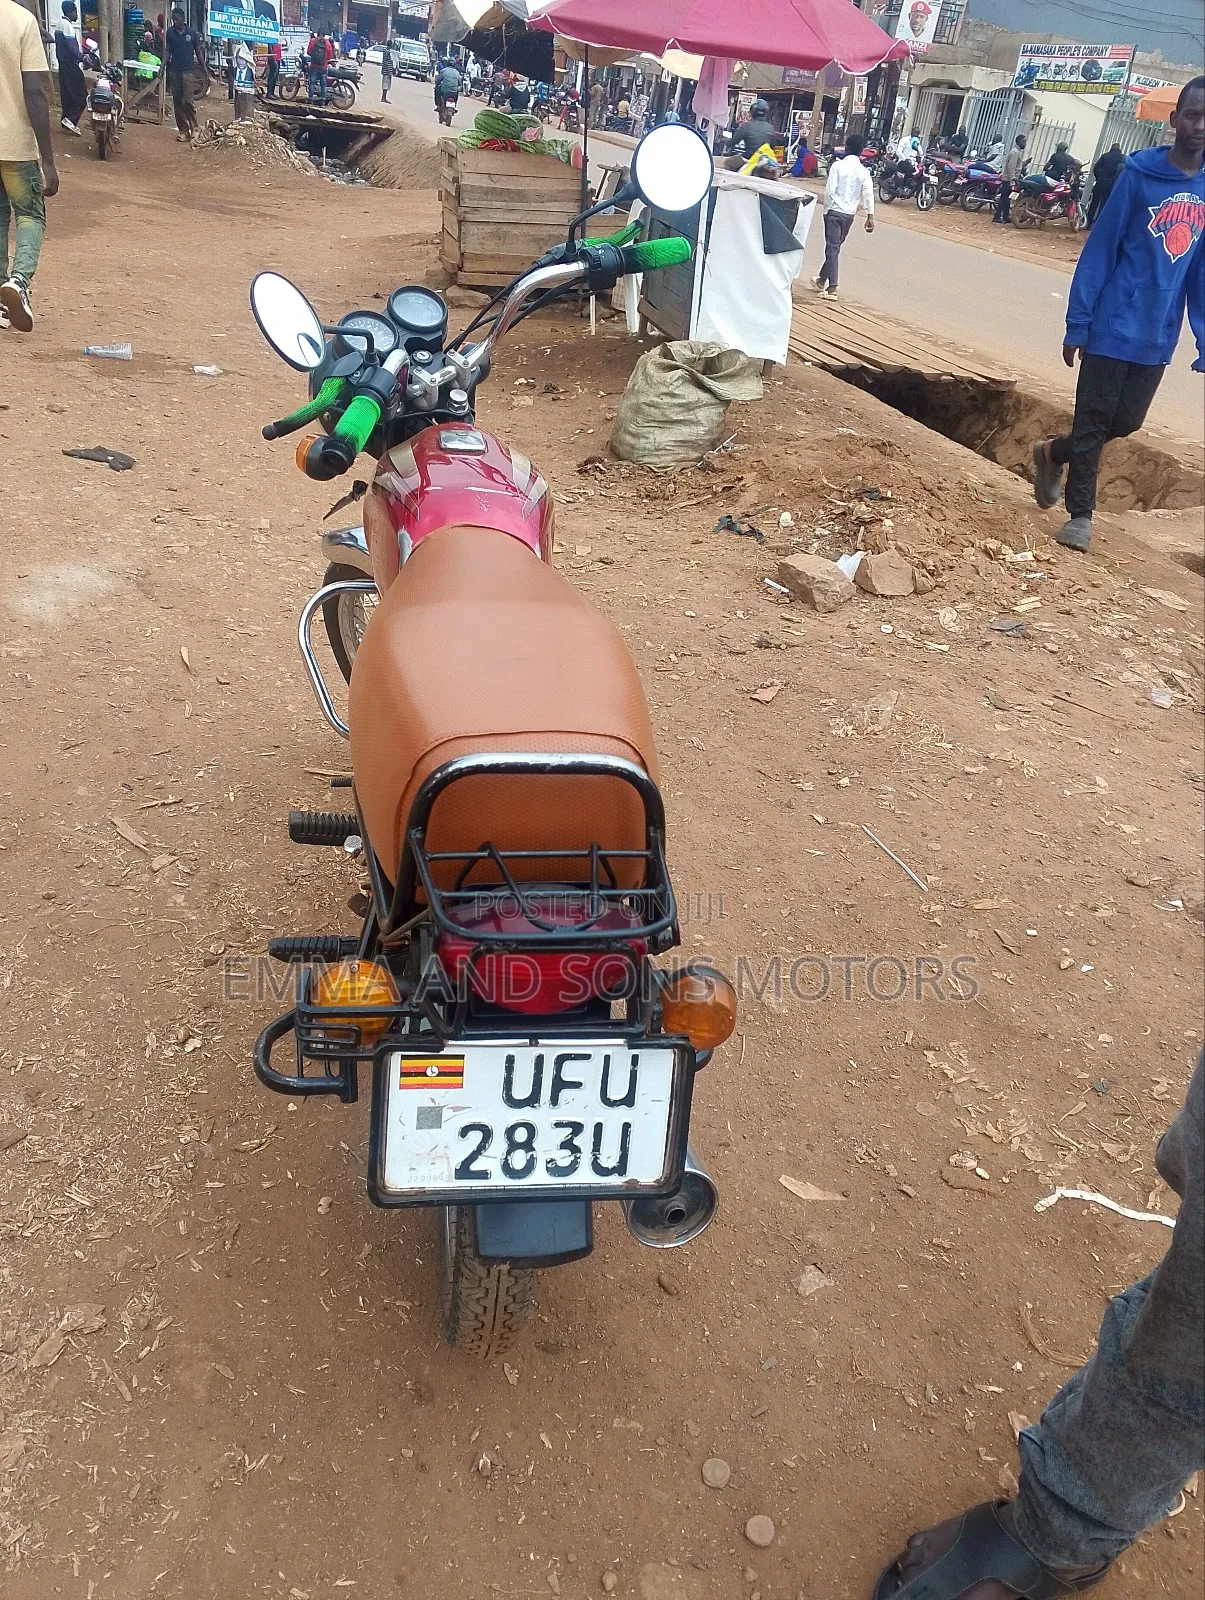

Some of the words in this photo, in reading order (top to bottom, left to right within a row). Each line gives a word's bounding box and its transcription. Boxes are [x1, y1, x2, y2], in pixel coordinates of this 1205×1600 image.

[214, 13, 229, 23] MP.
[231, 16, 274, 30] NANSANA
[220, 24, 268, 36] MUNICIPALITY
[1056, 45, 1081, 57] PEOPLE'S
[1082, 46, 1109, 57] COMPANY
[1151, 202, 1204, 228] KNICKS
[502, 1053, 640, 1109] UFU
[454, 1120, 632, 1181] 283U
